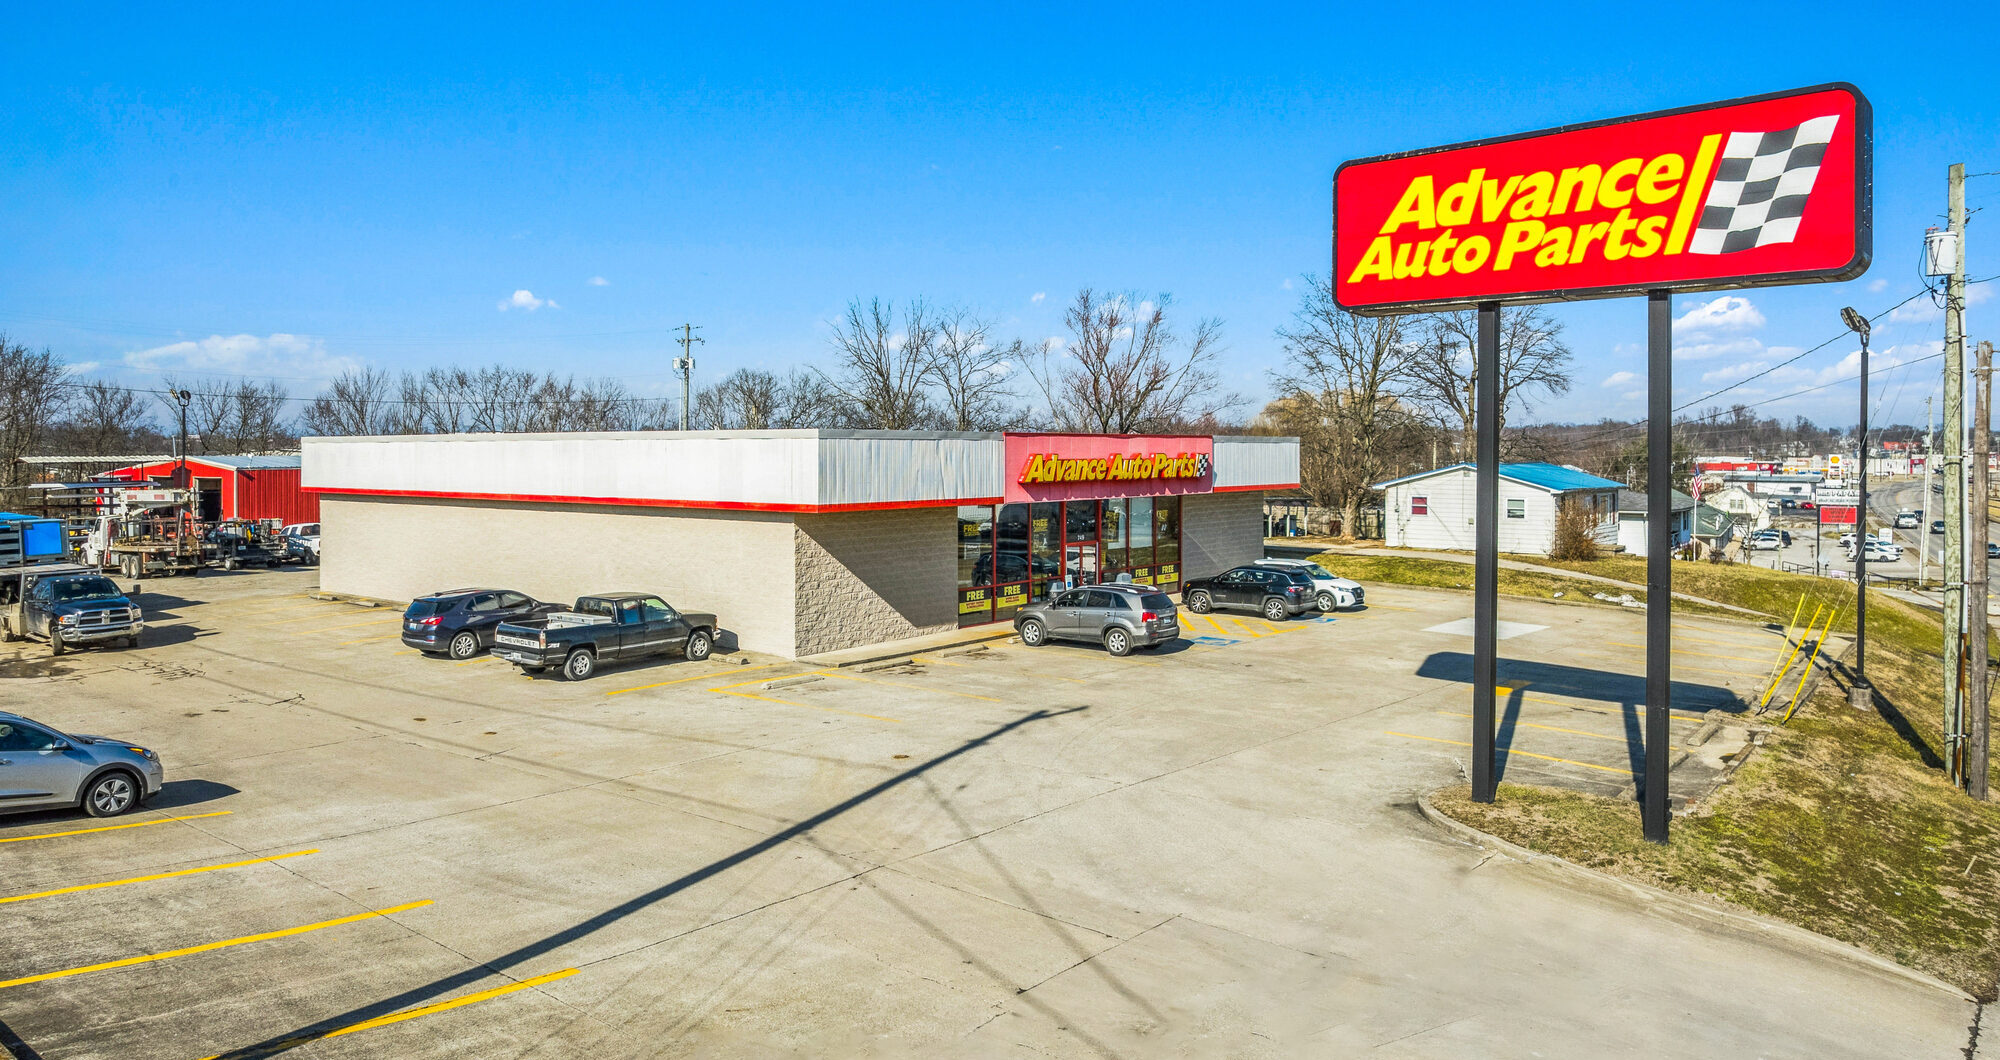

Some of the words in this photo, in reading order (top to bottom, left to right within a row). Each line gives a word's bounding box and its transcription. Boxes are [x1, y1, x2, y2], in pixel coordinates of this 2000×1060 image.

[1379, 152, 1685, 235] Advance
[1346, 228, 1491, 284] Auto
[1492, 208, 1669, 272] Parts
[1022, 453, 1107, 484] Advance
[1107, 453, 1152, 481] Auto
[1152, 452, 1194, 479] Parts
[1033, 519, 1048, 527] FREE
[1135, 568, 1148, 577] FREE
[1161, 565, 1174, 574] FREE
[1004, 585, 1021, 595] FREE
[966, 590, 985, 601] FREE
[500, 637, 535, 646] CHEVROLET
